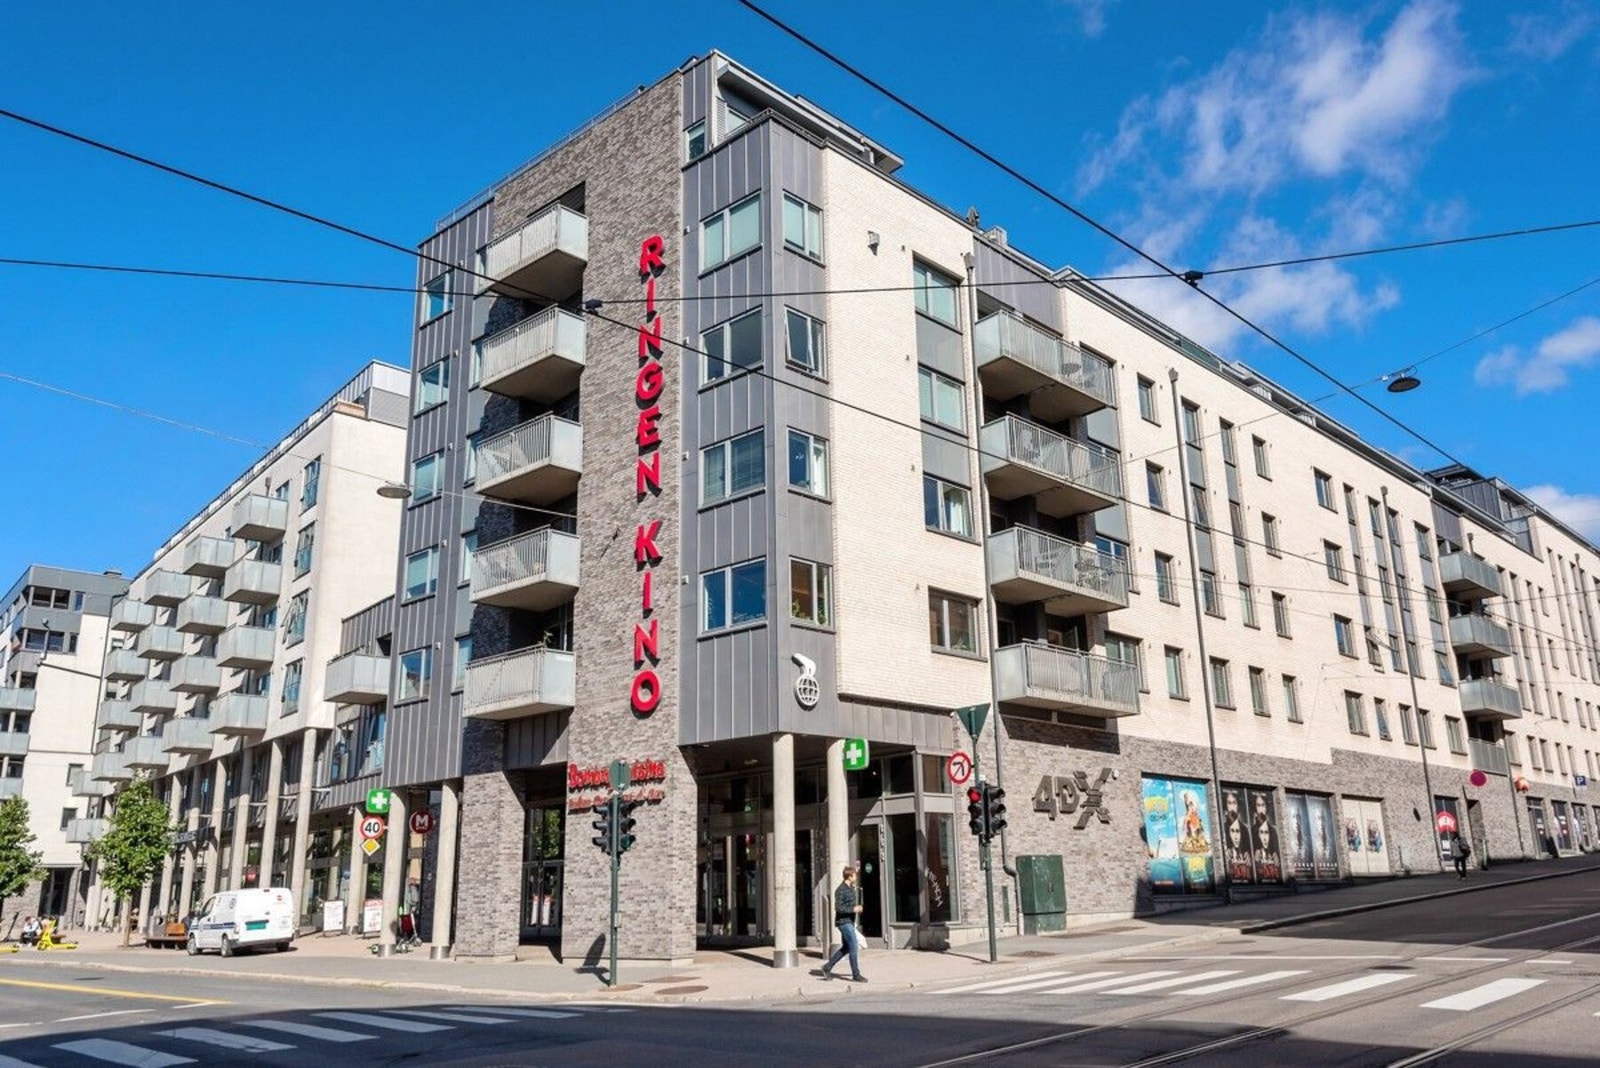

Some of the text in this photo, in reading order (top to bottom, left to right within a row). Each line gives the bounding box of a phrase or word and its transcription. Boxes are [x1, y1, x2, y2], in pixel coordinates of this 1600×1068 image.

[631, 235, 665, 715] RINGEN KINO
[1031, 768, 1113, 830] 4DX
[365, 822, 380, 834] 40
[415, 814, 429, 827] M
